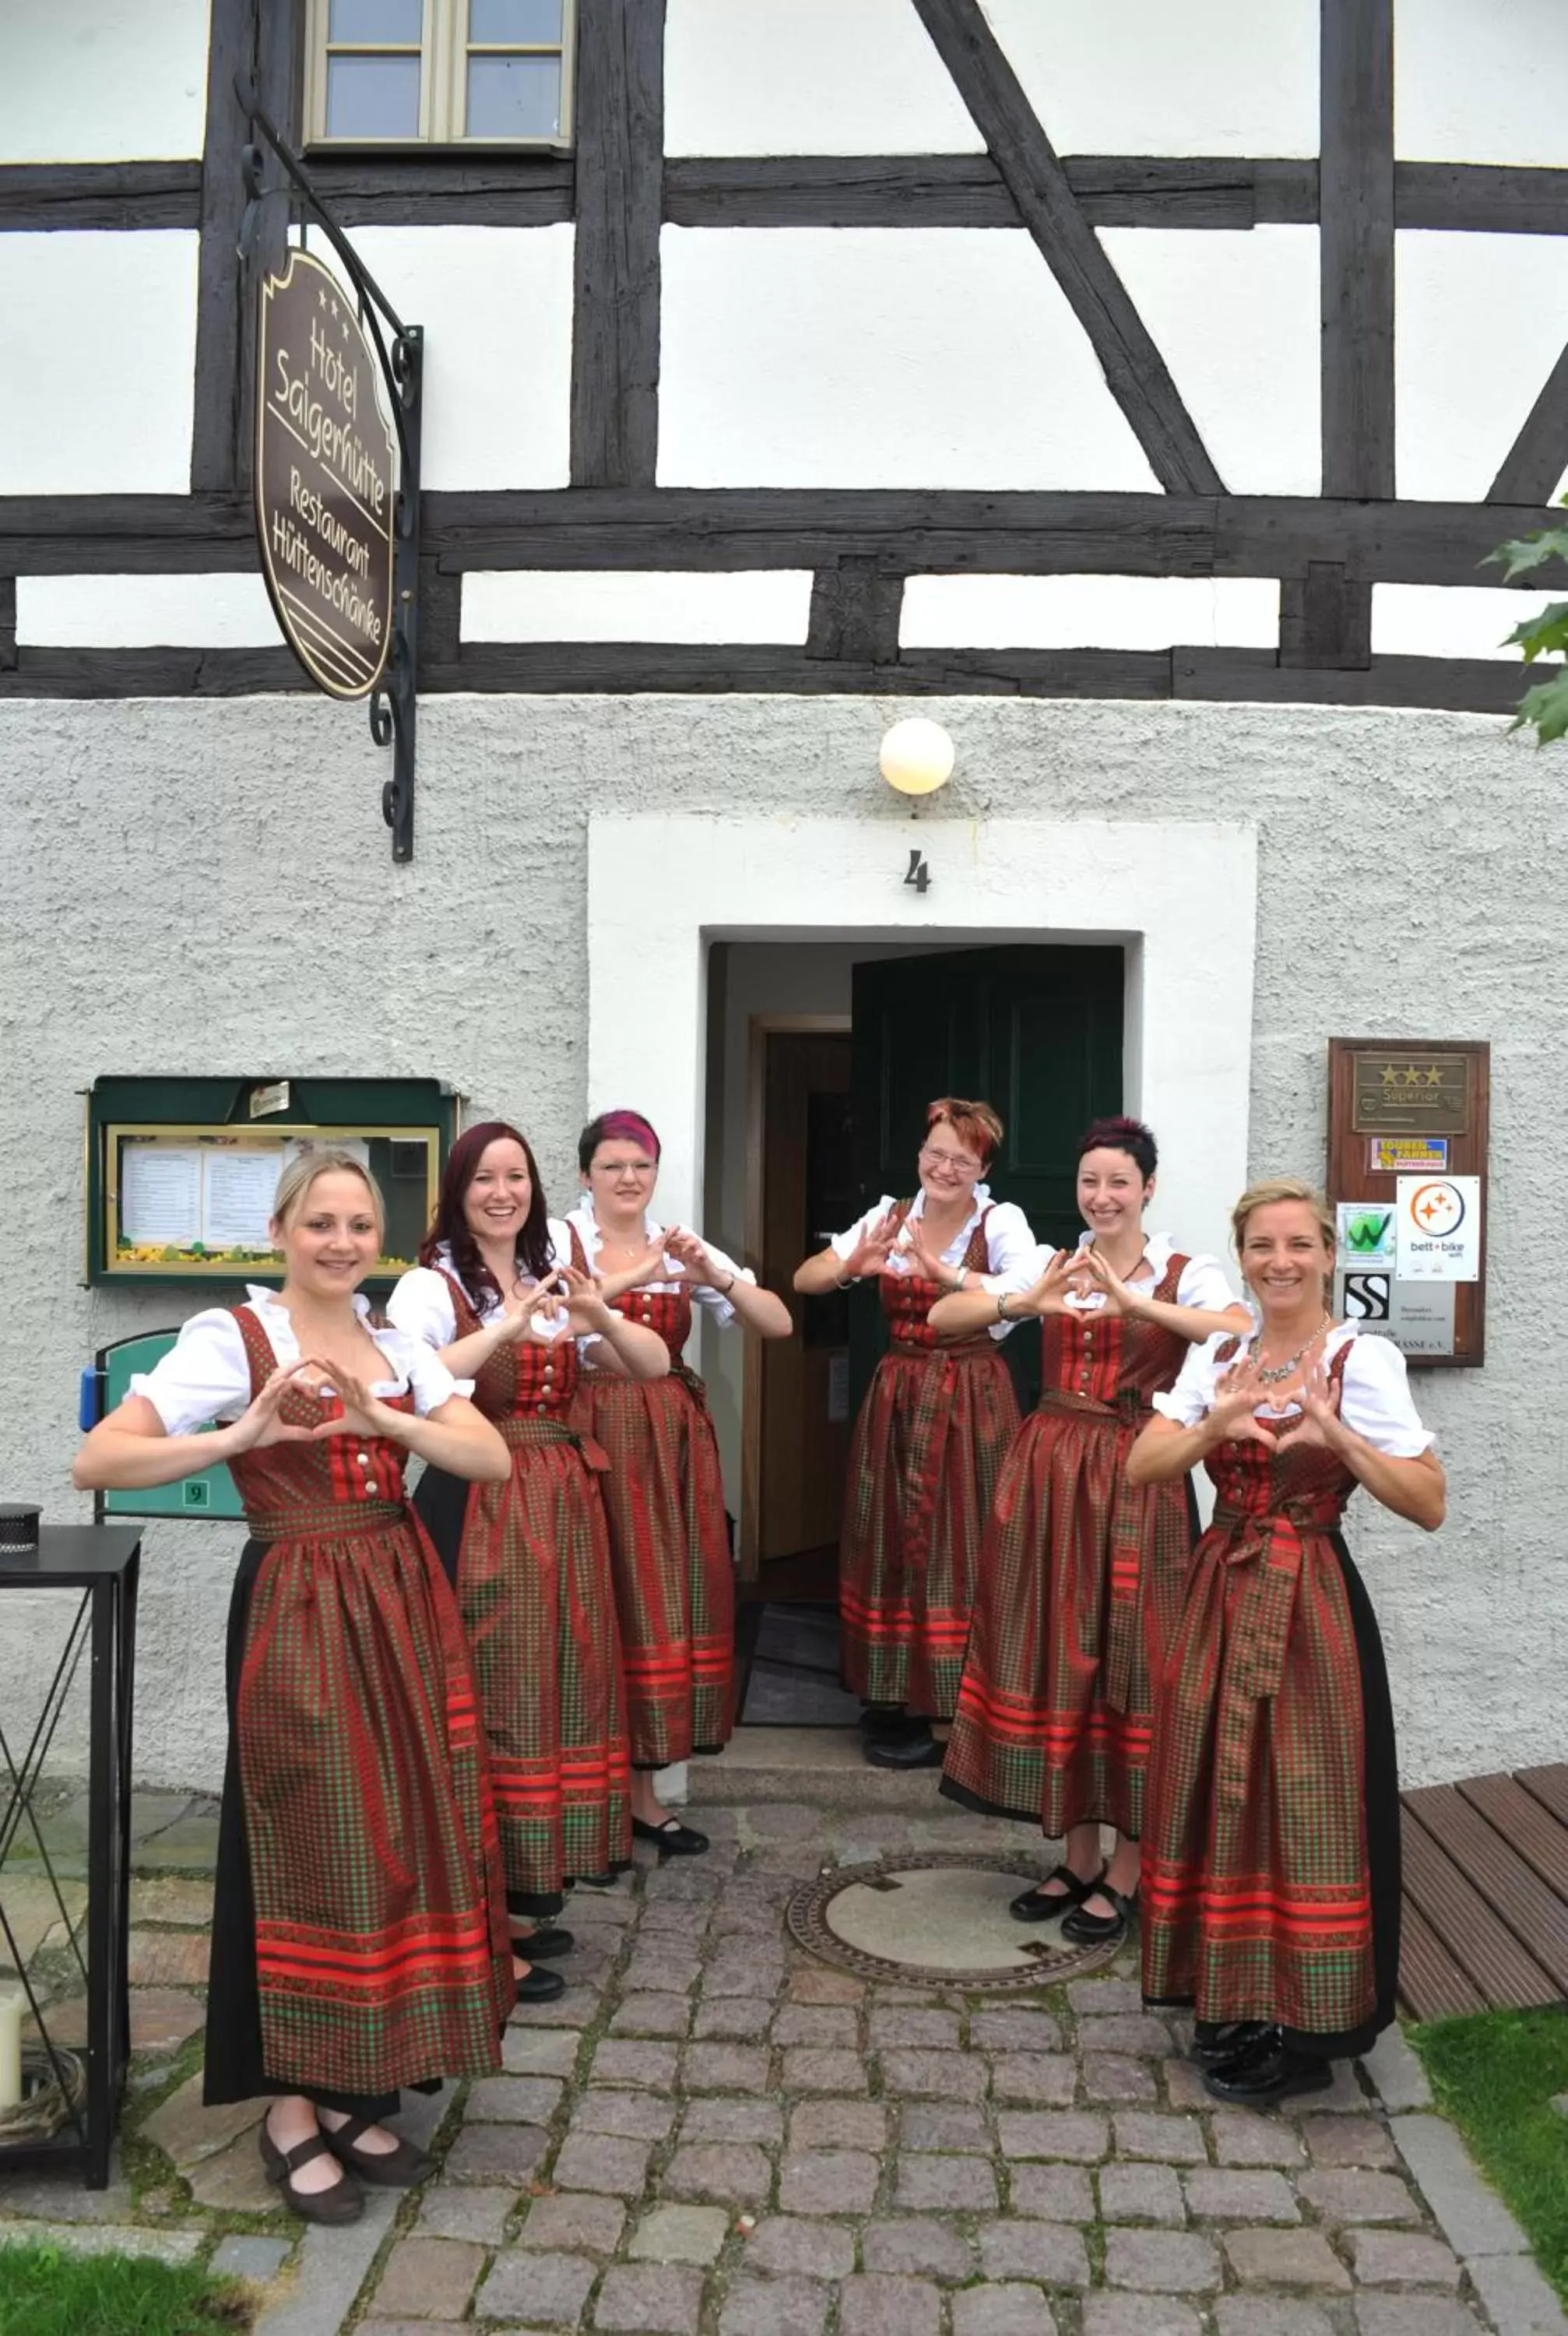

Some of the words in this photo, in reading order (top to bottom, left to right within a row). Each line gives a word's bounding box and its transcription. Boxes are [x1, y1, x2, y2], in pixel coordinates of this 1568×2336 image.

[310, 317, 357, 421] Hotel
[275, 349, 385, 515] Saigerhütte
[290, 466, 370, 580] Restaurant
[273, 510, 381, 646] Hüttenschänke
[903, 850, 932, 893] 4
[1383, 1087, 1440, 1103] Superior
[191, 1486, 202, 1501] 9
